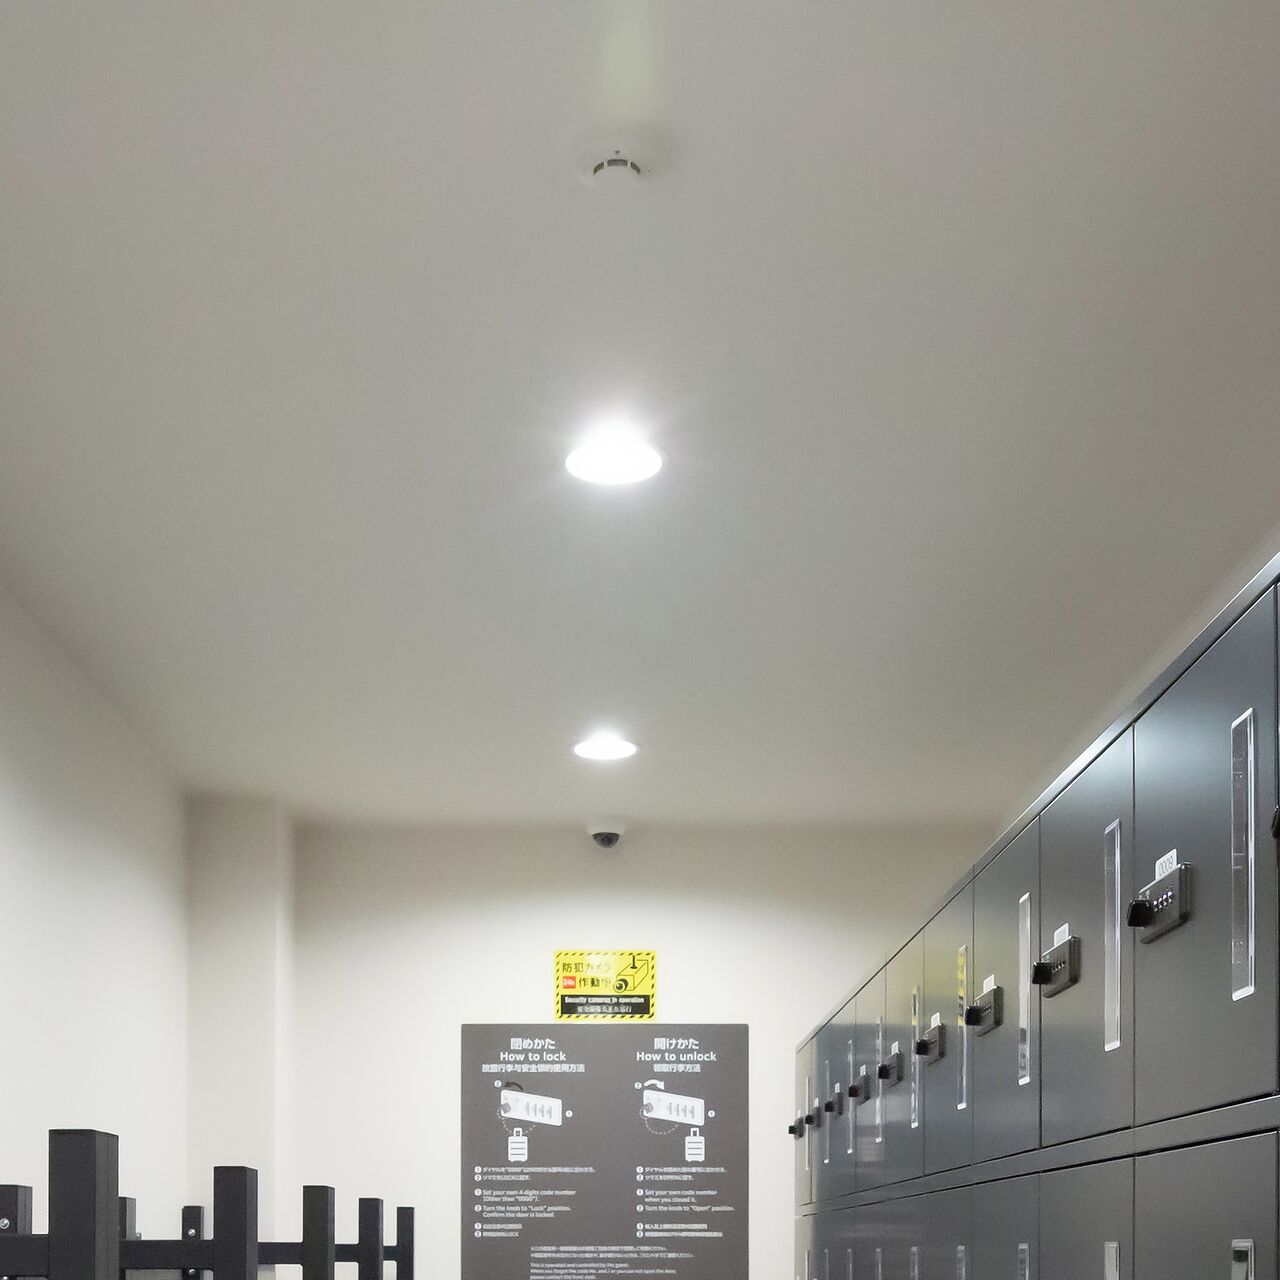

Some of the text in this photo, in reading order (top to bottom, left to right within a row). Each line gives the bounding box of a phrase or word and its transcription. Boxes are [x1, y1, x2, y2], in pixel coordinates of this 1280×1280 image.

[1159, 855, 1174, 876] 0009
[653, 1037, 700, 1050] 開けかた
[500, 1051, 567, 1061] How to lock
[636, 1051, 717, 1061] How to unlock
